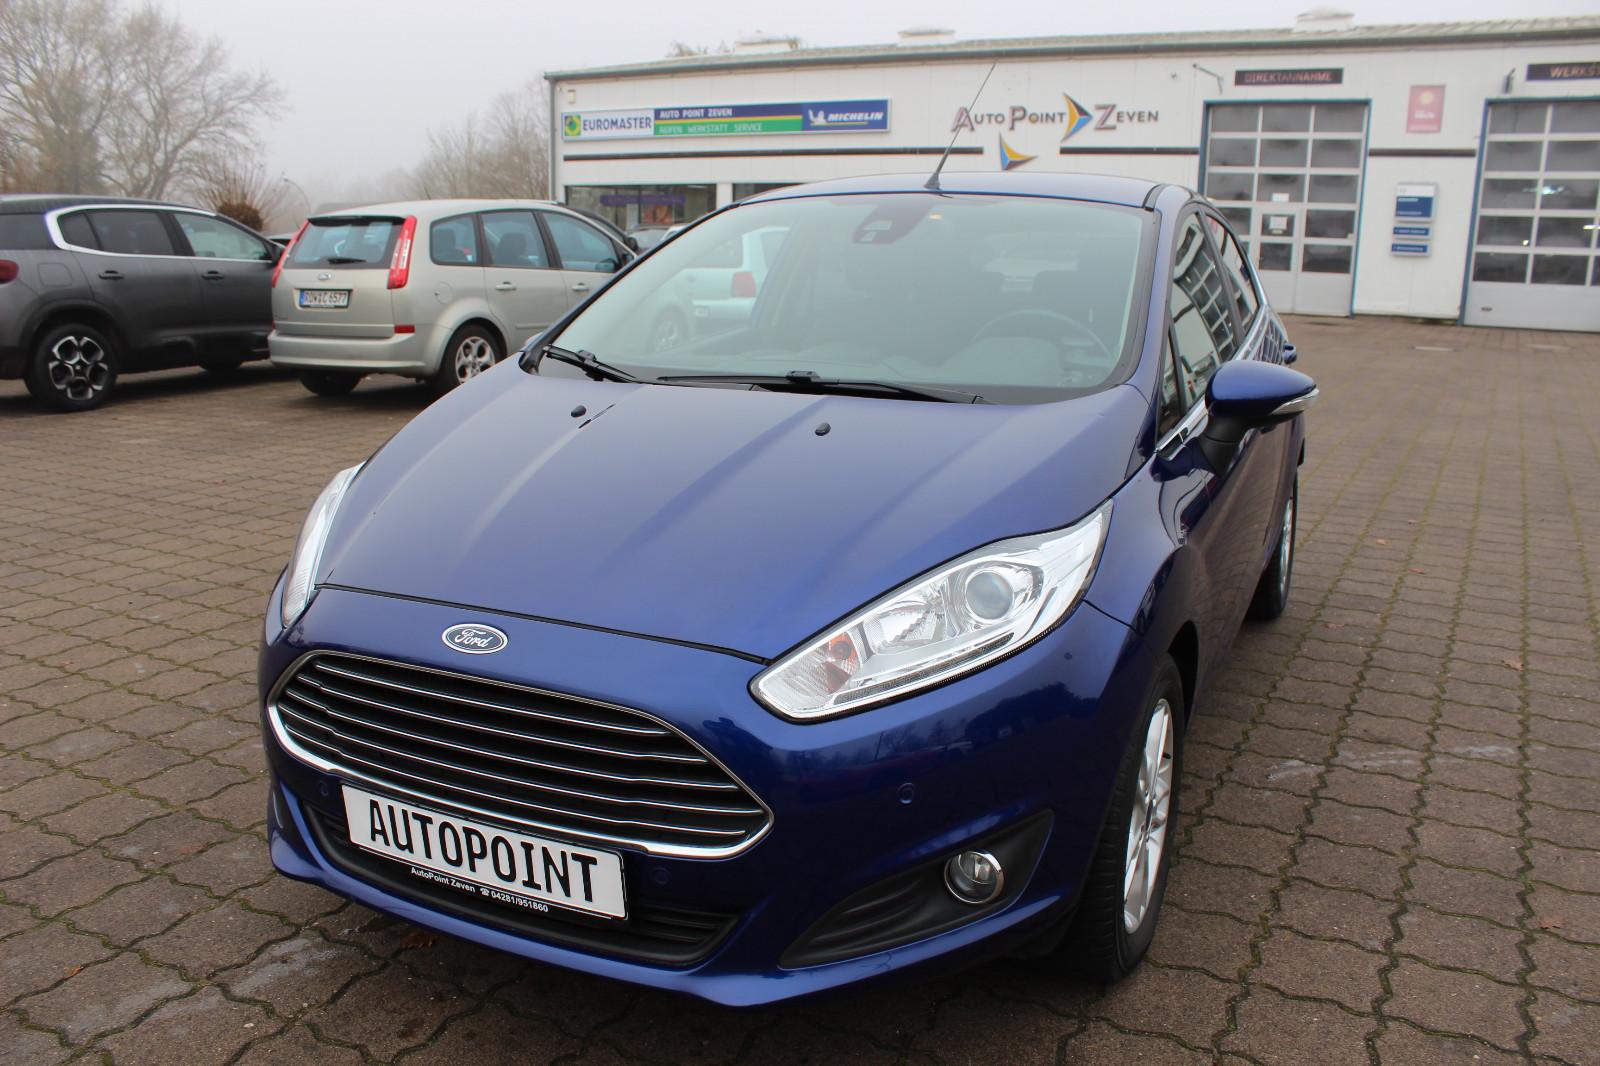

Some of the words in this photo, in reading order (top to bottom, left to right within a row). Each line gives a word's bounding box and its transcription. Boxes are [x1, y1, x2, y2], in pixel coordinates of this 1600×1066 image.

[1244, 71, 1333, 83] DIREKTANNAHME
[660, 110, 680, 118] AUTO
[683, 109, 704, 117] POINT
[708, 107, 733, 117] ZEVEN
[827, 111, 884, 121] MICHELIN
[950, 106, 1006, 133] AUTO
[1008, 105, 1067, 131] POINT
[1093, 103, 1160, 131] ZEVEN
[582, 116, 652, 131] EUROMASTER
[688, 123, 728, 133] WERKSTATT
[734, 122, 763, 132] SERVICE
[454, 628, 493, 647] Ford
[369, 799, 598, 903] AUTOPOINT
[411, 866, 450, 885] AutoPoint
[450, 879, 476, 893] Zeven
[490, 891, 549, 913] 04281/951860
